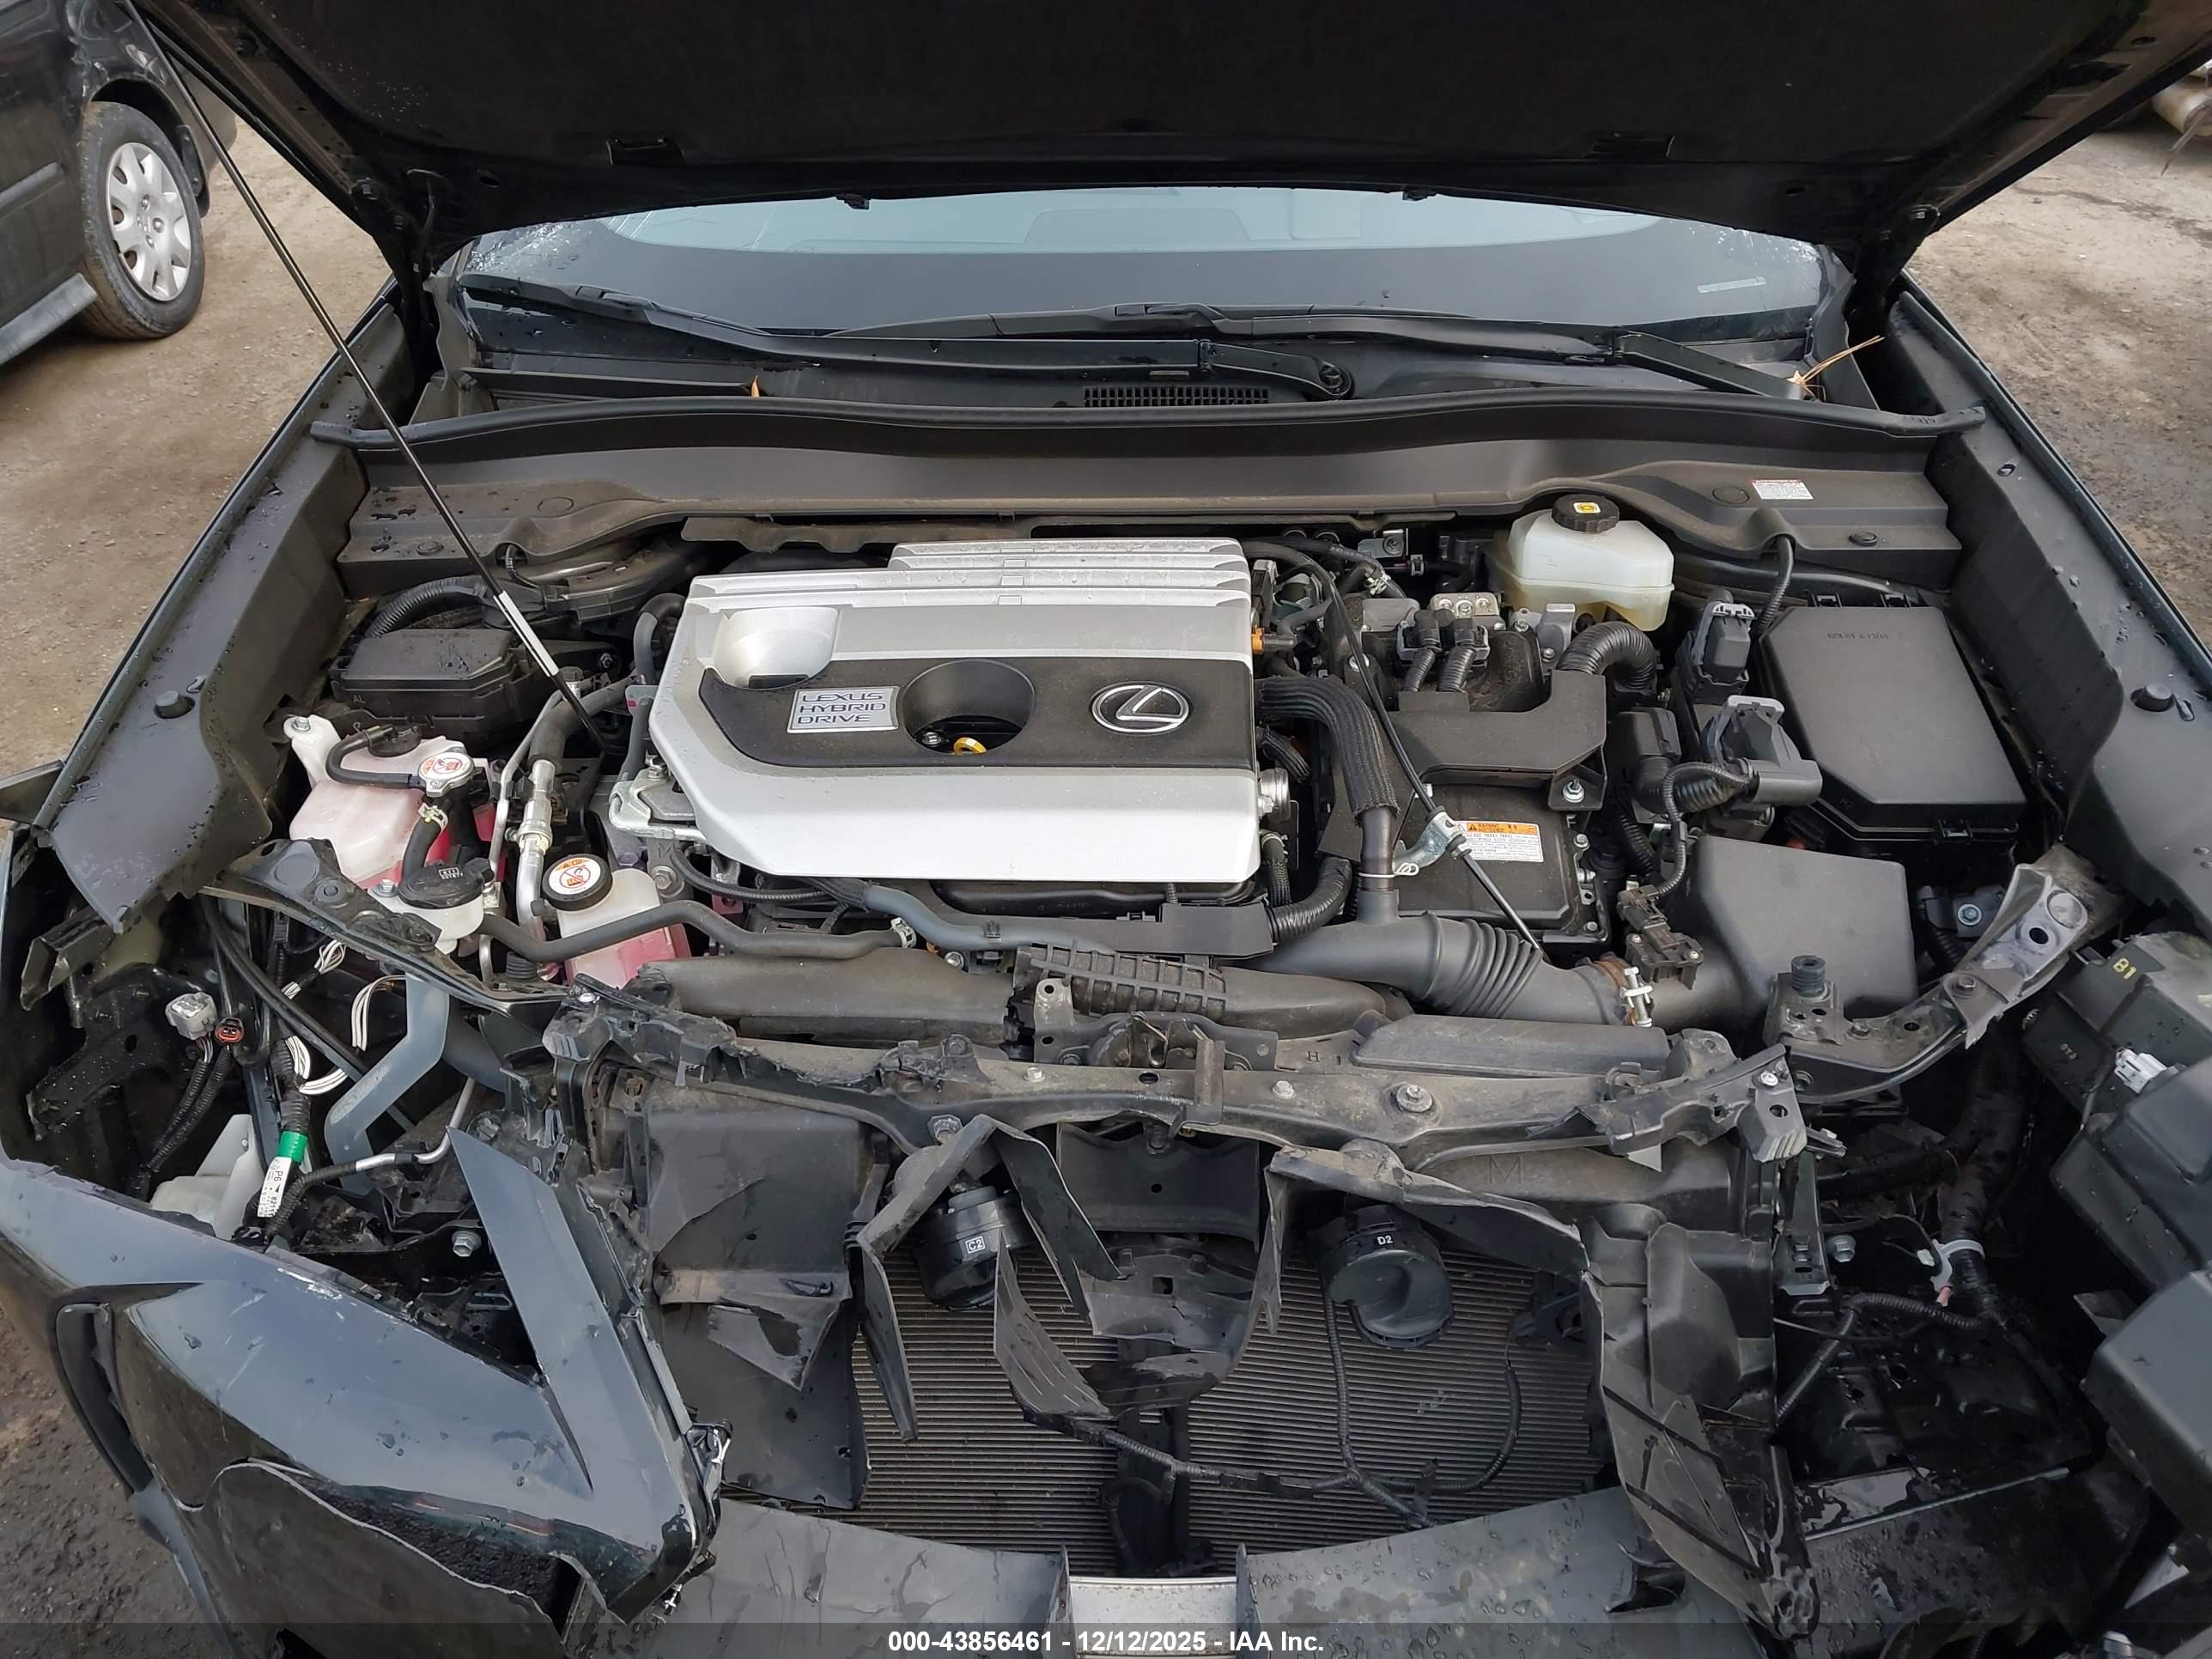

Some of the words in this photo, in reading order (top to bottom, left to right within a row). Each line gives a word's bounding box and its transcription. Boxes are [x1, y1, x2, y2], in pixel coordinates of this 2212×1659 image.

[803, 692, 884, 702] LEXUS
[799, 702, 886, 714] HYBRID
[797, 714, 872, 725] DRIVE
[968, 1238, 983, 1251] C2
[1376, 1234, 1394, 1246] D2
